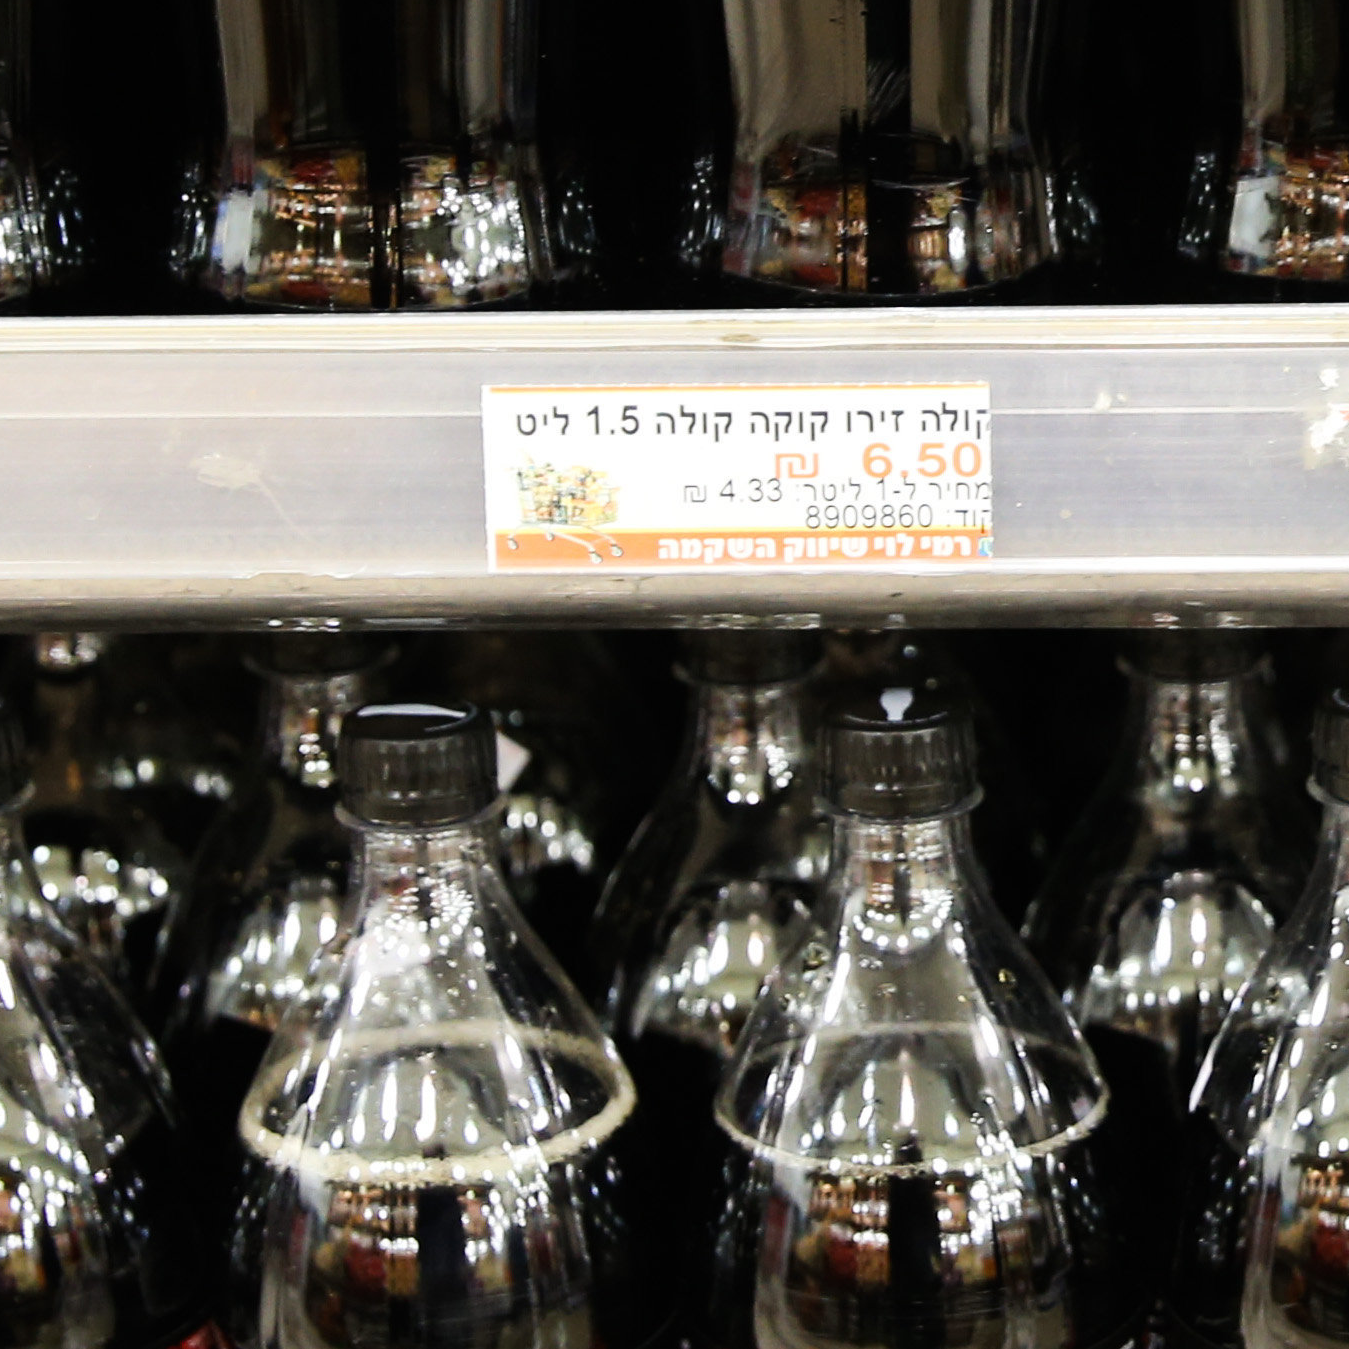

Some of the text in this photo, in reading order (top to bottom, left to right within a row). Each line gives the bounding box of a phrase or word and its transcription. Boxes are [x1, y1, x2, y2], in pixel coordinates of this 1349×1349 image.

[515, 406, 570, 436] ליט
[585, 405, 641, 436] 1.5
[655, 405, 733, 442] קולה
[750, 410, 829, 442] קוקה
[846, 408, 905, 434] זירו
[862, 441, 982, 478] 6.50
[719, 477, 783, 503] 4.33
[805, 503, 933, 529] 8909860
[658, 533, 971, 564] רמי לוי שיווק השקמה
